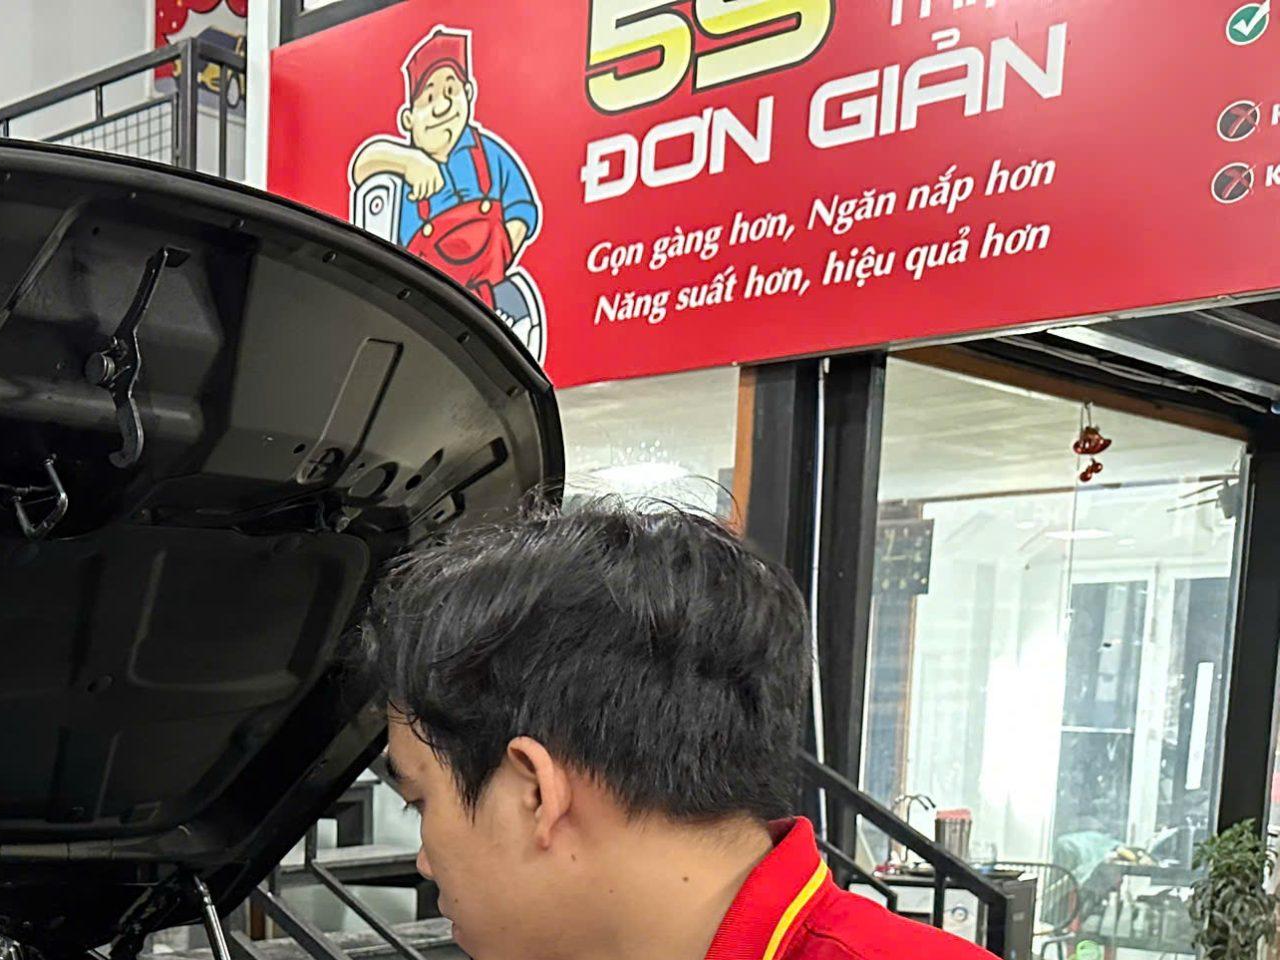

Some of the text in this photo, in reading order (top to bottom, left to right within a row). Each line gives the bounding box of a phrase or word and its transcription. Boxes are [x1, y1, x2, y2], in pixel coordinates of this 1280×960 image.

[580, 22, 1068, 204] ĐƠN GIẢN
[586, 159, 1056, 276] Gọn gàng hơn, Ngăn nắp hơn
[593, 222, 1051, 325] Năng suất hơn, hiệu quả hơn
